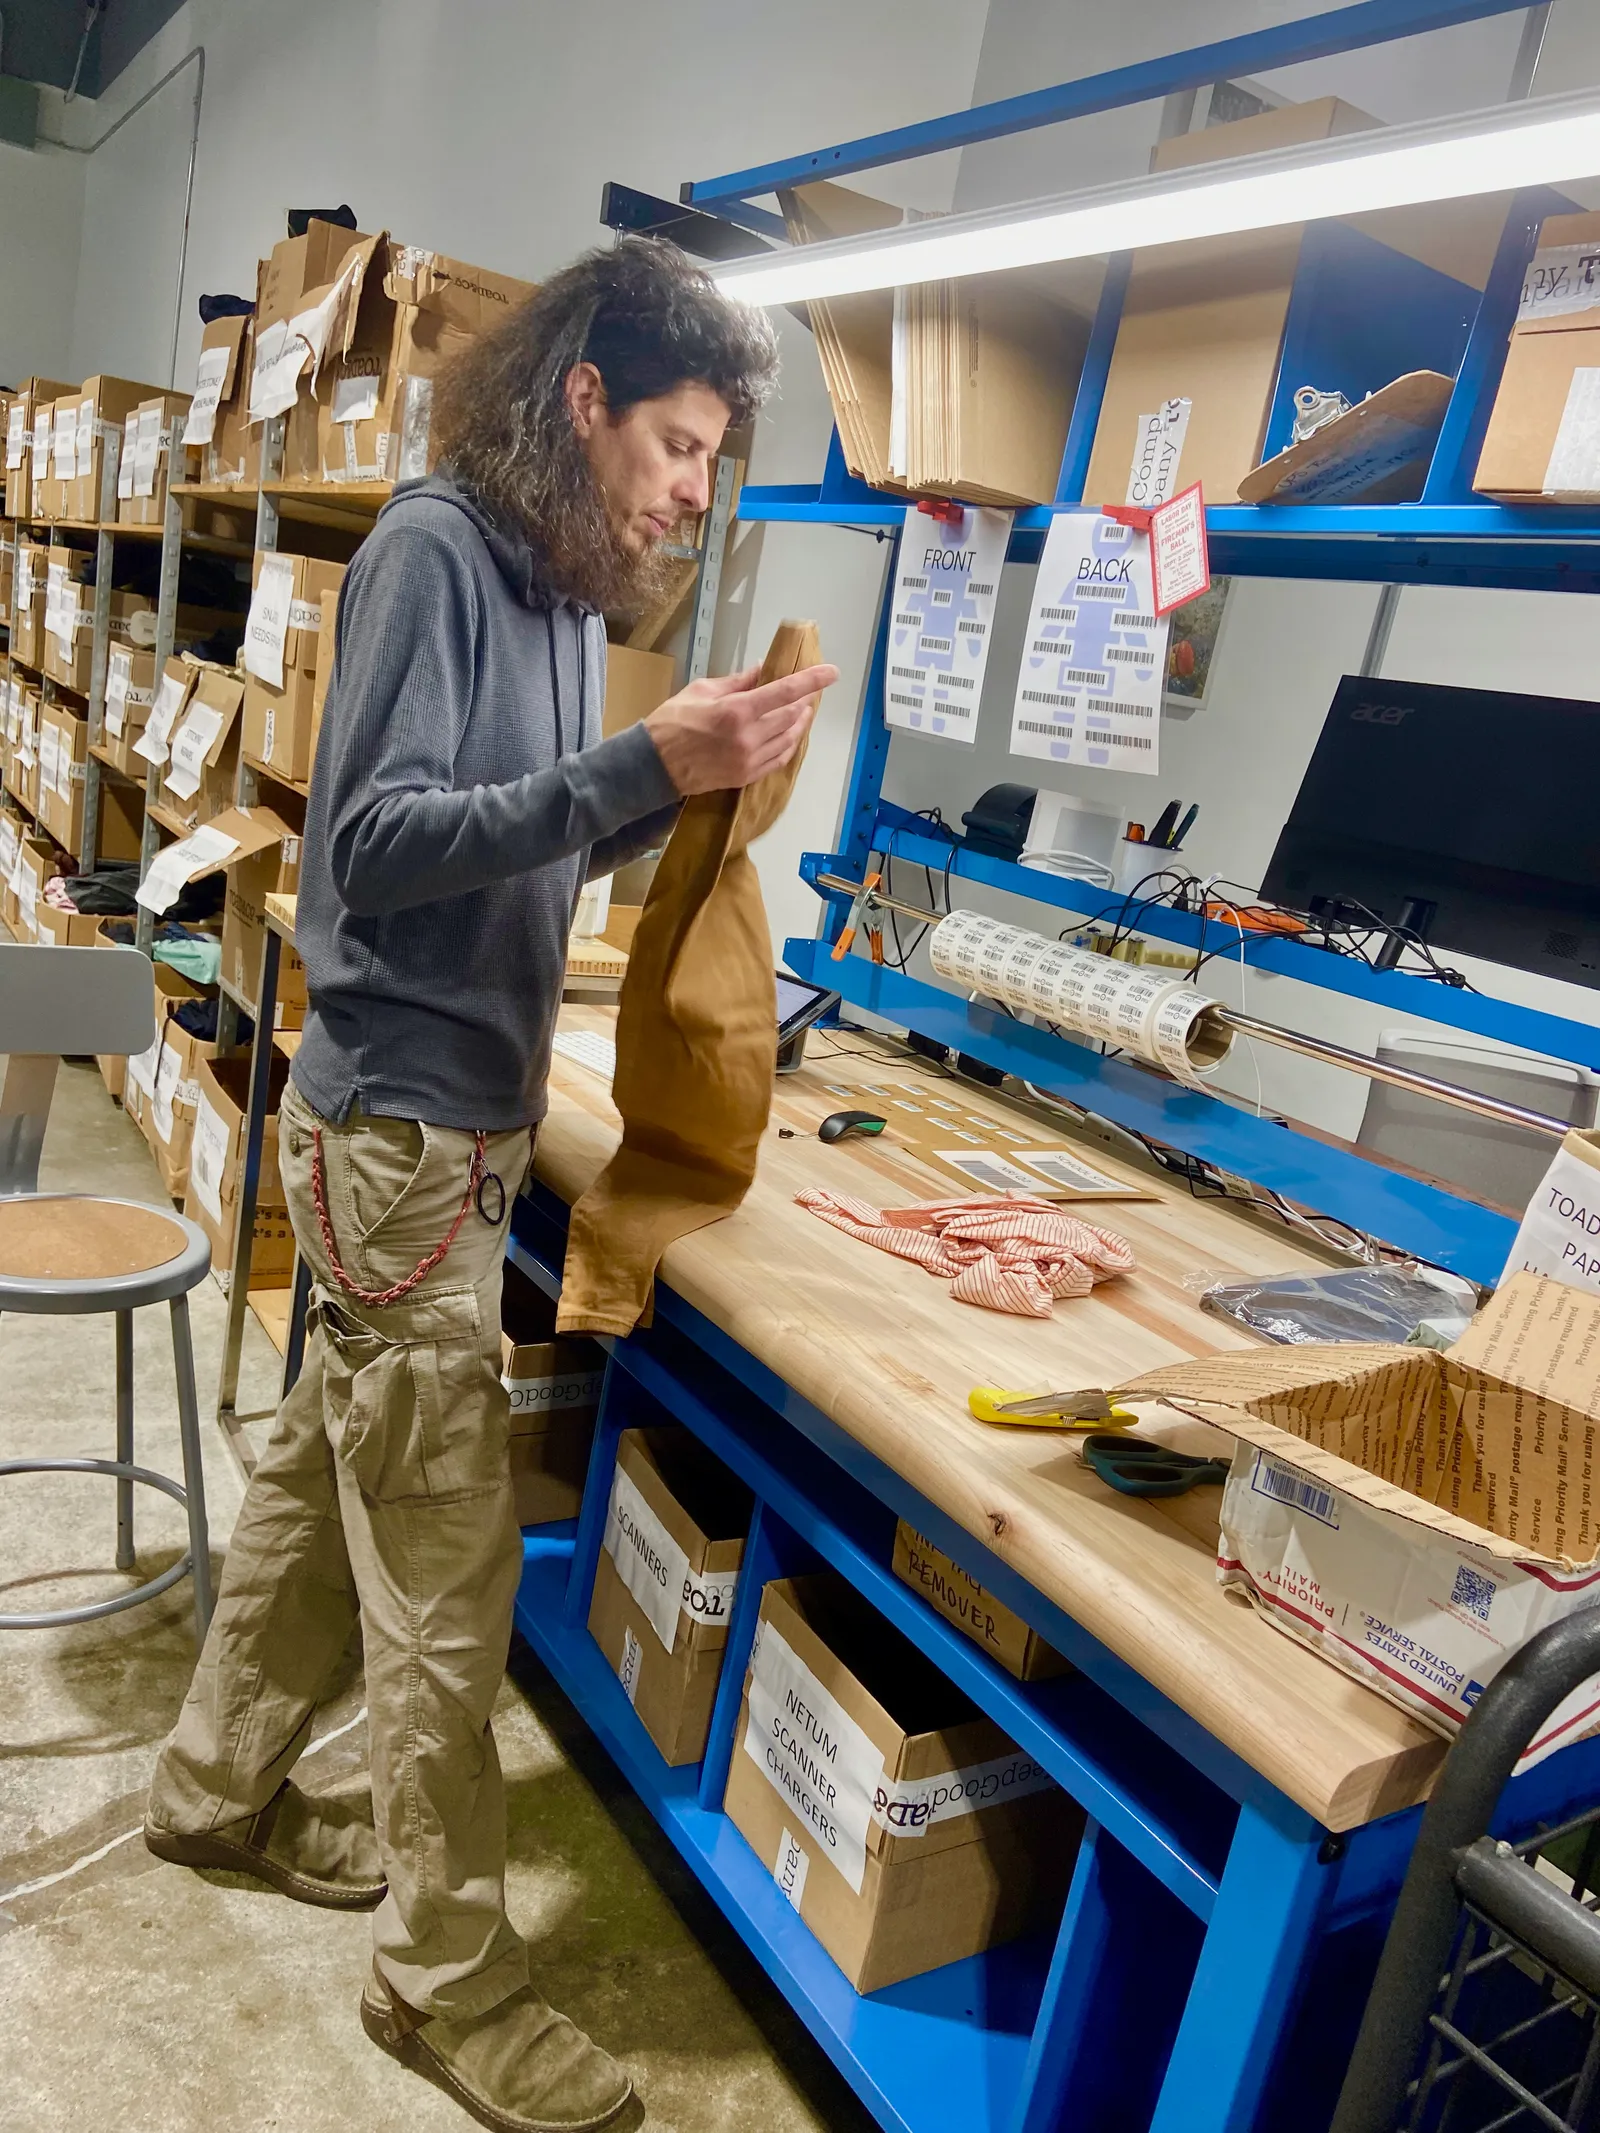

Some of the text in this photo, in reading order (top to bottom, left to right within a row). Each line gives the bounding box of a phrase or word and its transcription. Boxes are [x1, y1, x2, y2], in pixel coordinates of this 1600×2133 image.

[1161, 508, 1180, 526] LABOR
[1181, 501, 1192, 514] DAY
[1161, 520, 1196, 547] FIREMAN'S
[1170, 536, 1187, 551] BALL
[922, 548, 976, 573] FRONT
[1077, 557, 1135, 583] BACK
[1350, 703, 1415, 726] acer
[1548, 1187, 1600, 1235] TOAD
[1499, 1289, 1519, 1320] Service
[1549, 1296, 1567, 1321] Thank
[1508, 1346, 1520, 1363] you
[1514, 1332, 1526, 1346] for
[1521, 1308, 1538, 1332] using
[1575, 1333, 1597, 1367] Priority
[1477, 1379, 1488, 1411] using
[1534, 1409, 1548, 1454] Priority
[1545, 1343, 1565, 1379] postage
[1560, 1306, 1579, 1342] required
[1438, 1394, 1449, 1412] for
[1513, 1376, 1526, 1423] required
[1439, 1414, 1449, 1436] you
[1476, 1412, 1485, 1430] for
[1558, 1398, 1572, 1442] Service
[1415, 1413, 1427, 1489] using Priority
[1436, 1438, 1447, 1472] Thank
[1475, 1434, 1485, 1456] you
[1511, 1426, 1524, 1475] postage
[1582, 1425, 1596, 1459] using
[1451, 1432, 1464, 1509] using Priority
[1473, 1458, 1483, 1493] Thank
[1581, 1461, 1592, 1480] for
[1486, 1471, 1497, 1522] required
[1554, 1479, 1569, 1525] Priority
[1582, 1482, 1592, 1506] you
[1530, 1498, 1542, 1544] Service
[1578, 1508, 1590, 1546] Thank
[617, 1505, 669, 1587] SCANNERS
[1284, 1565, 1321, 1594] MAIL
[908, 1549, 1001, 1647] REMOVER
[1364, 1631, 1459, 1695] UNITED STATES
[1419, 1645, 1466, 1683] POSTAL
[785, 1688, 839, 1764] NETUM
[771, 1717, 838, 1809] SCANNER
[765, 1747, 838, 1848] CHARGERS
